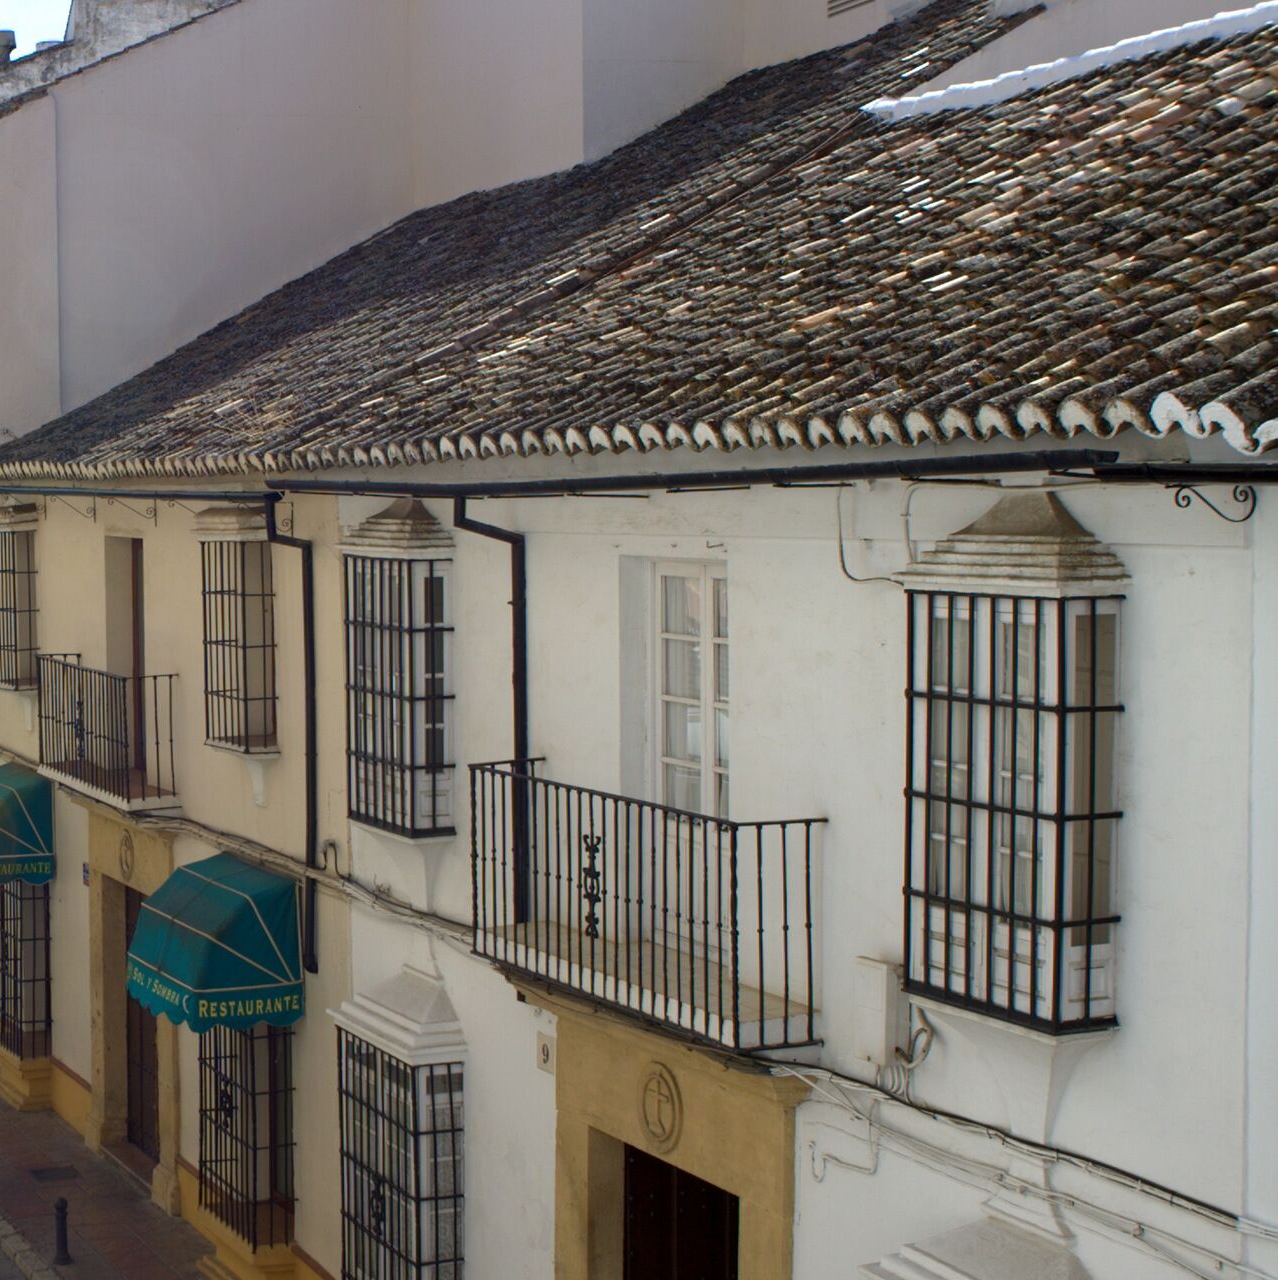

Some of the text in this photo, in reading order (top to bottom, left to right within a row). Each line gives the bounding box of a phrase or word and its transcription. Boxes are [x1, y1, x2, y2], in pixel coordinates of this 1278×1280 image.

[152, 979, 180, 1006] SOMBRA
[198, 995, 299, 1018] RESTAURANTE
[542, 1043, 549, 1064] 9
